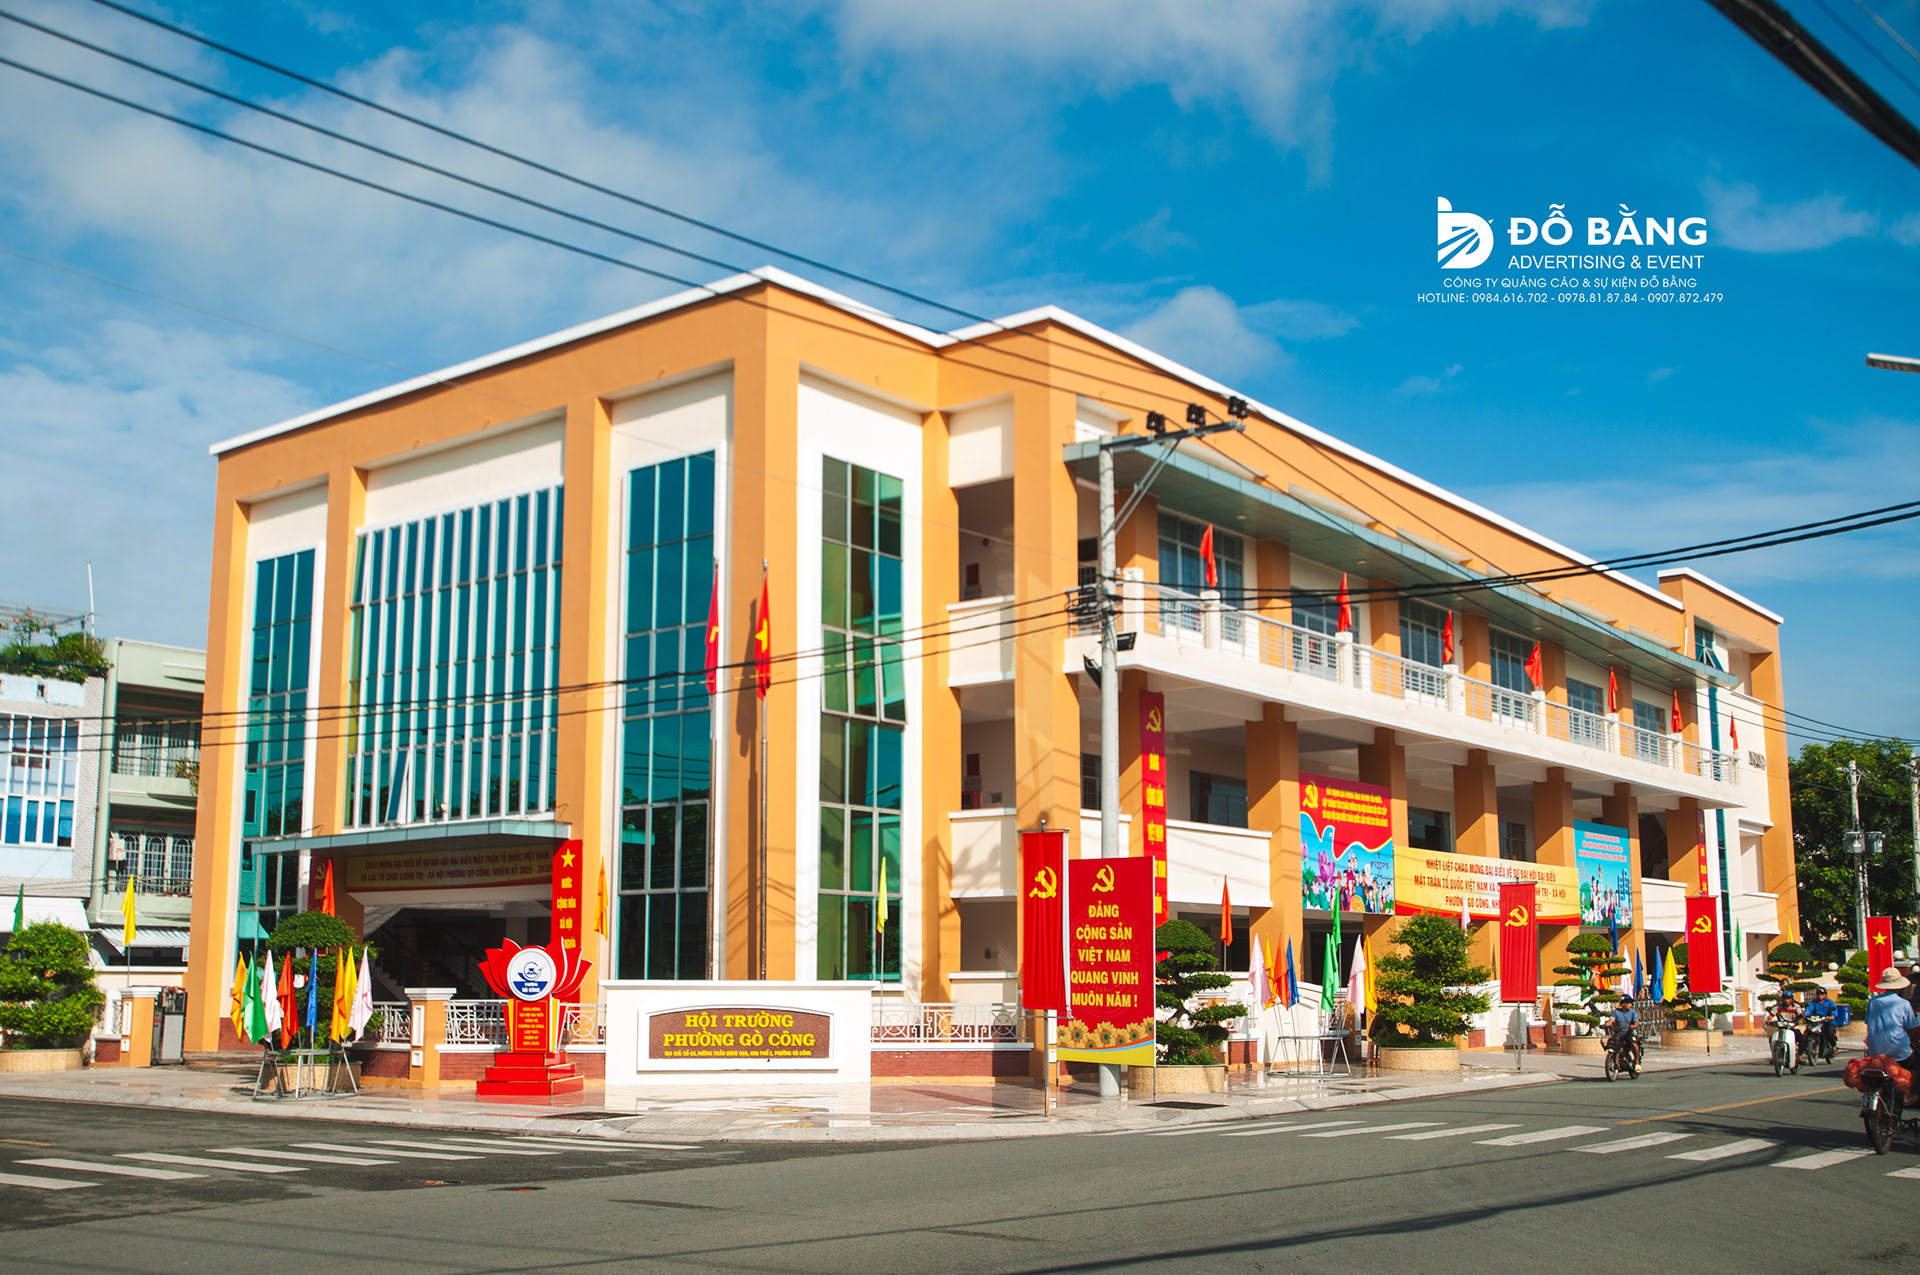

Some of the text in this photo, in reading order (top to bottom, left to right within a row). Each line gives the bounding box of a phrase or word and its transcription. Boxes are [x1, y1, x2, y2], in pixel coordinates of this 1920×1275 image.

[1445, 894, 1463, 906] PHƯỜN
[1088, 900, 1119, 918] ĐẢNG
[1076, 922, 1132, 944] CỘNG SẢN
[1078, 946, 1130, 965] VIỆT NAM
[1071, 970, 1138, 985] QUANG VINH
[1072, 990, 1138, 1007] MUÔN NĂM !
[685, 1011, 794, 1030] HỘI TRƯỜNG
[663, 1030, 815, 1047] PHƯỜNG GÒ CÔNG
